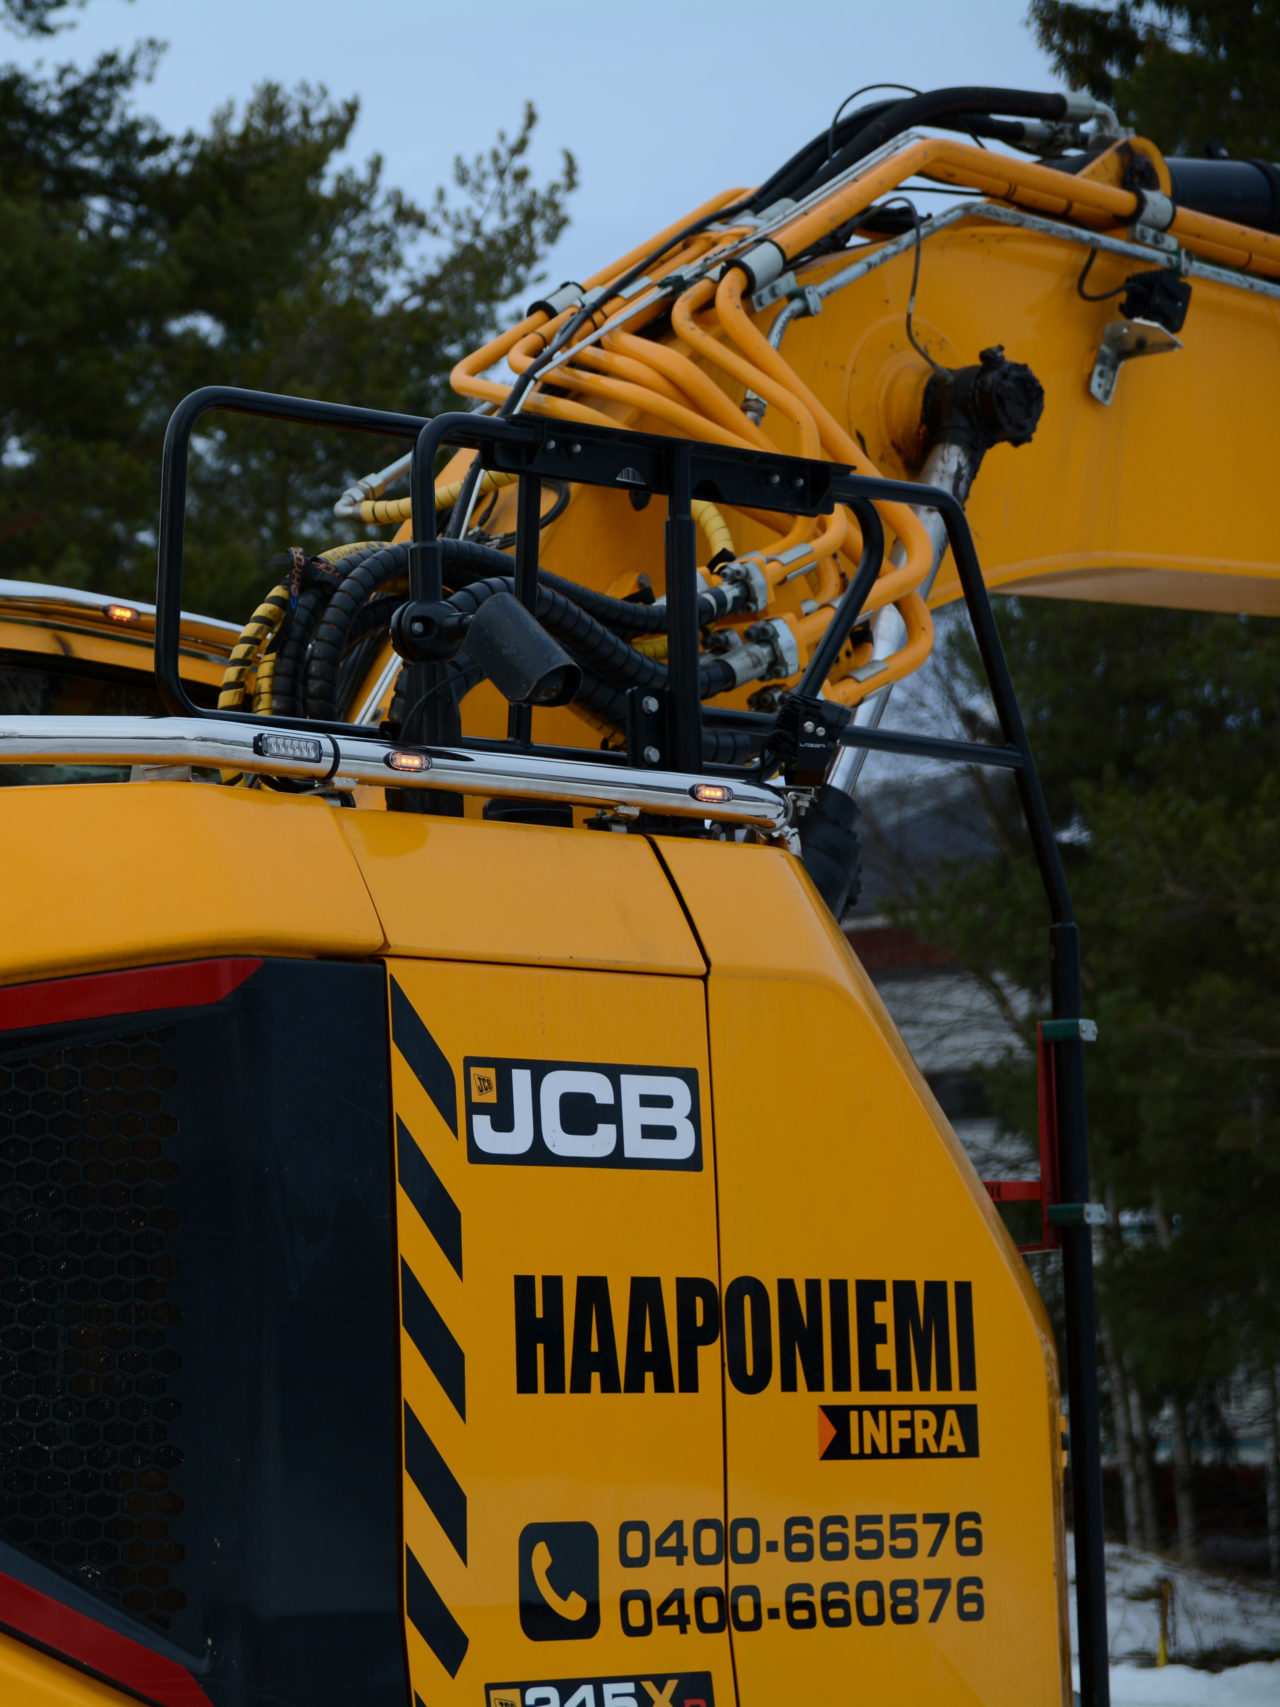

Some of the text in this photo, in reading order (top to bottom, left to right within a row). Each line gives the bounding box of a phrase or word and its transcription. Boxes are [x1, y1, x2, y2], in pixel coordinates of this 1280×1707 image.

[472, 1068, 696, 1160] JCB
[513, 1274, 978, 1395] HAAPONIEMI
[849, 1409, 967, 1455] INFRA
[618, 1511, 984, 1569] 0400-665576
[619, 1576, 985, 1638] 0400-660876
